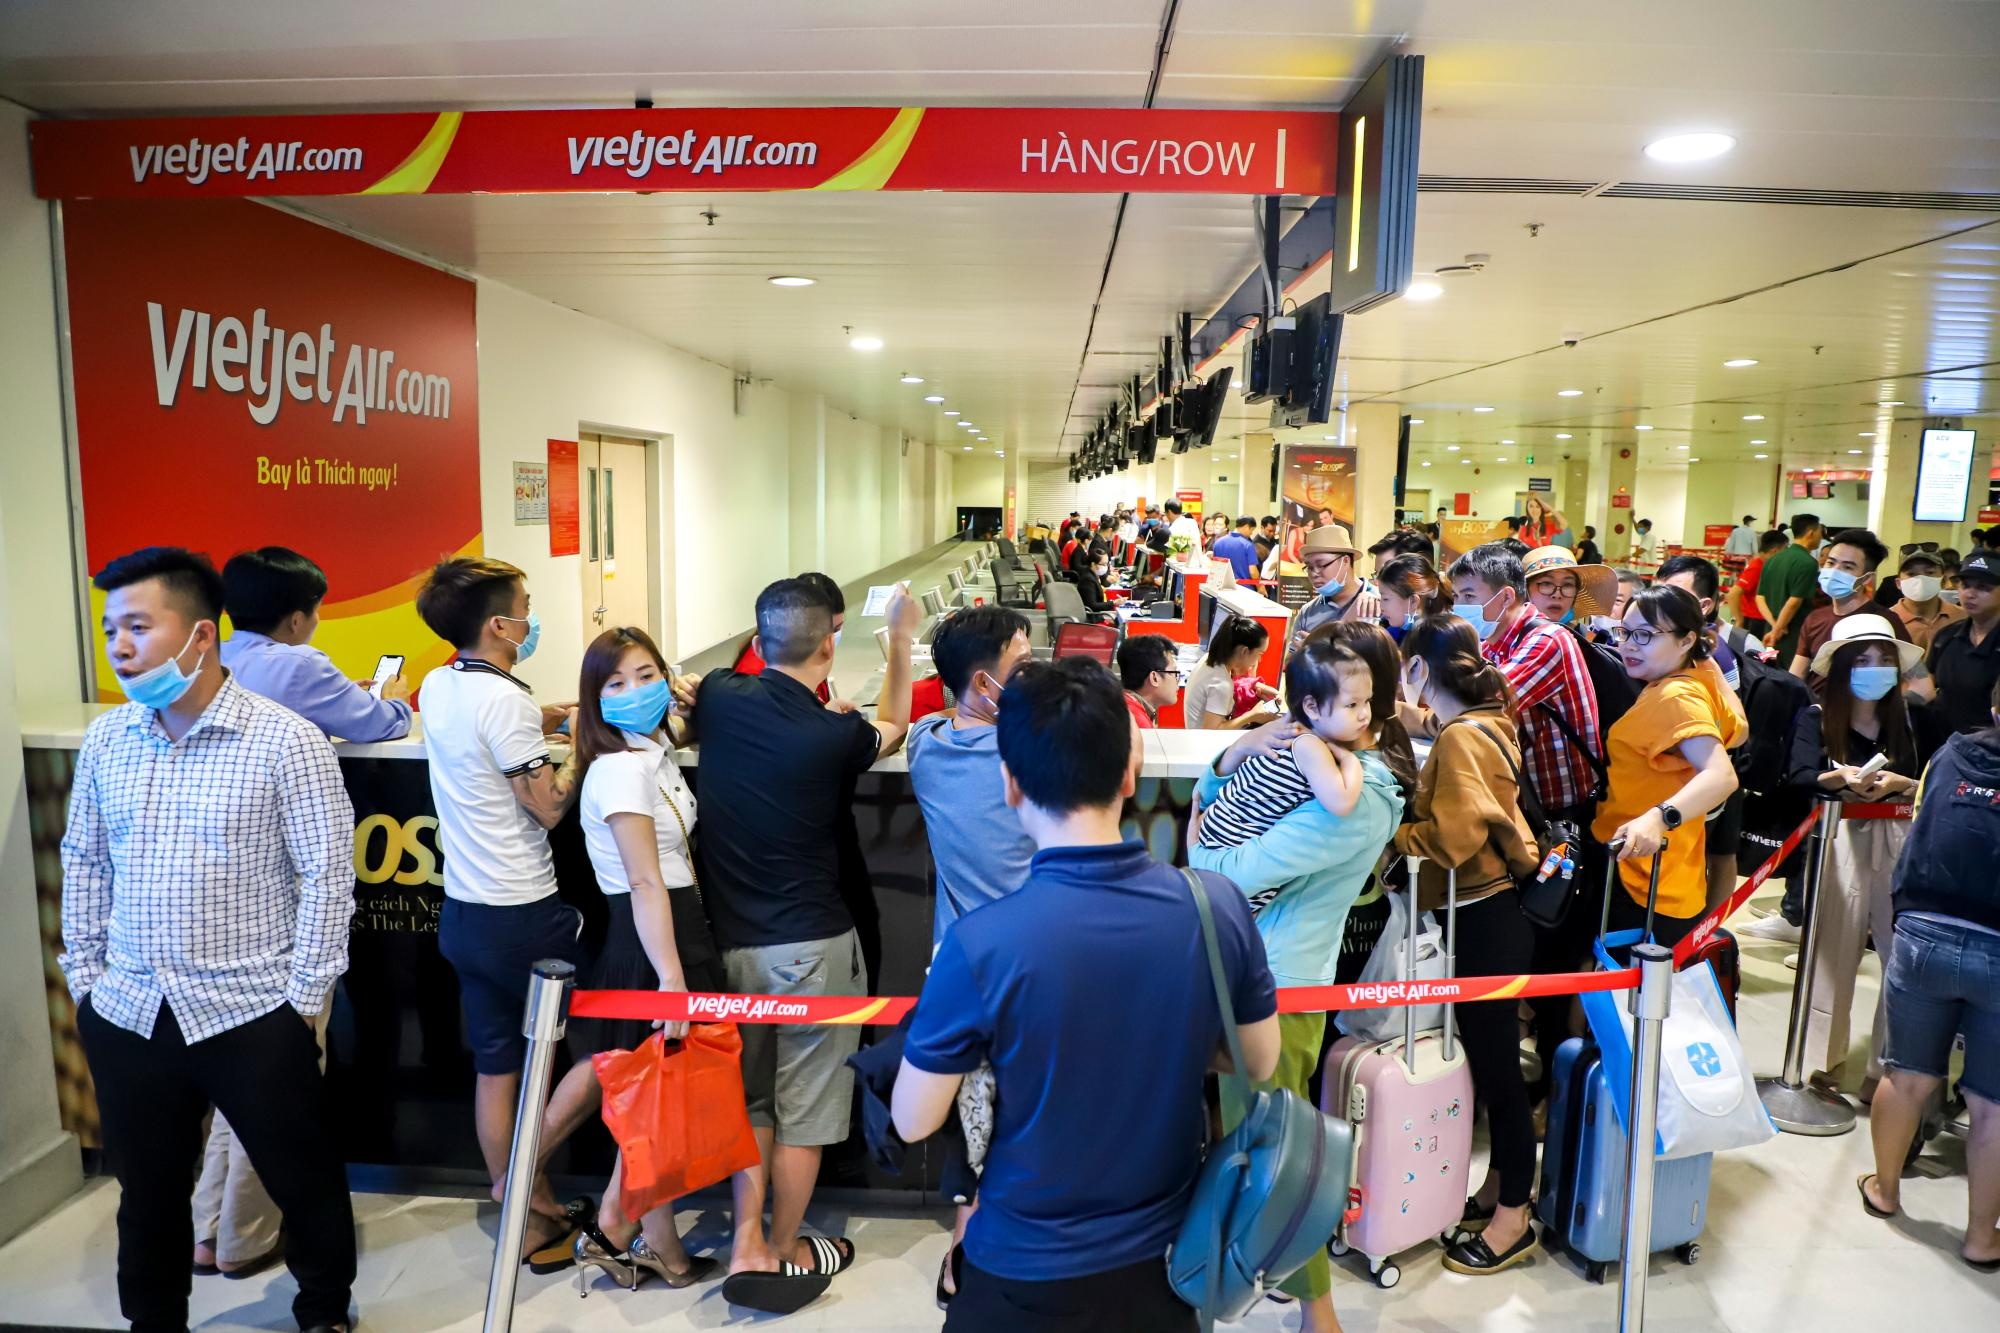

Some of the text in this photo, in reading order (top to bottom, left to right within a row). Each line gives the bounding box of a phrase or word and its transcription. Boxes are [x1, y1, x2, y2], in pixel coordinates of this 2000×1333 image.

[256, 456, 292, 488] Bay
[296, 458, 311, 483] là
[315, 460, 355, 485] Thích
[368, 914, 404, 931] The
